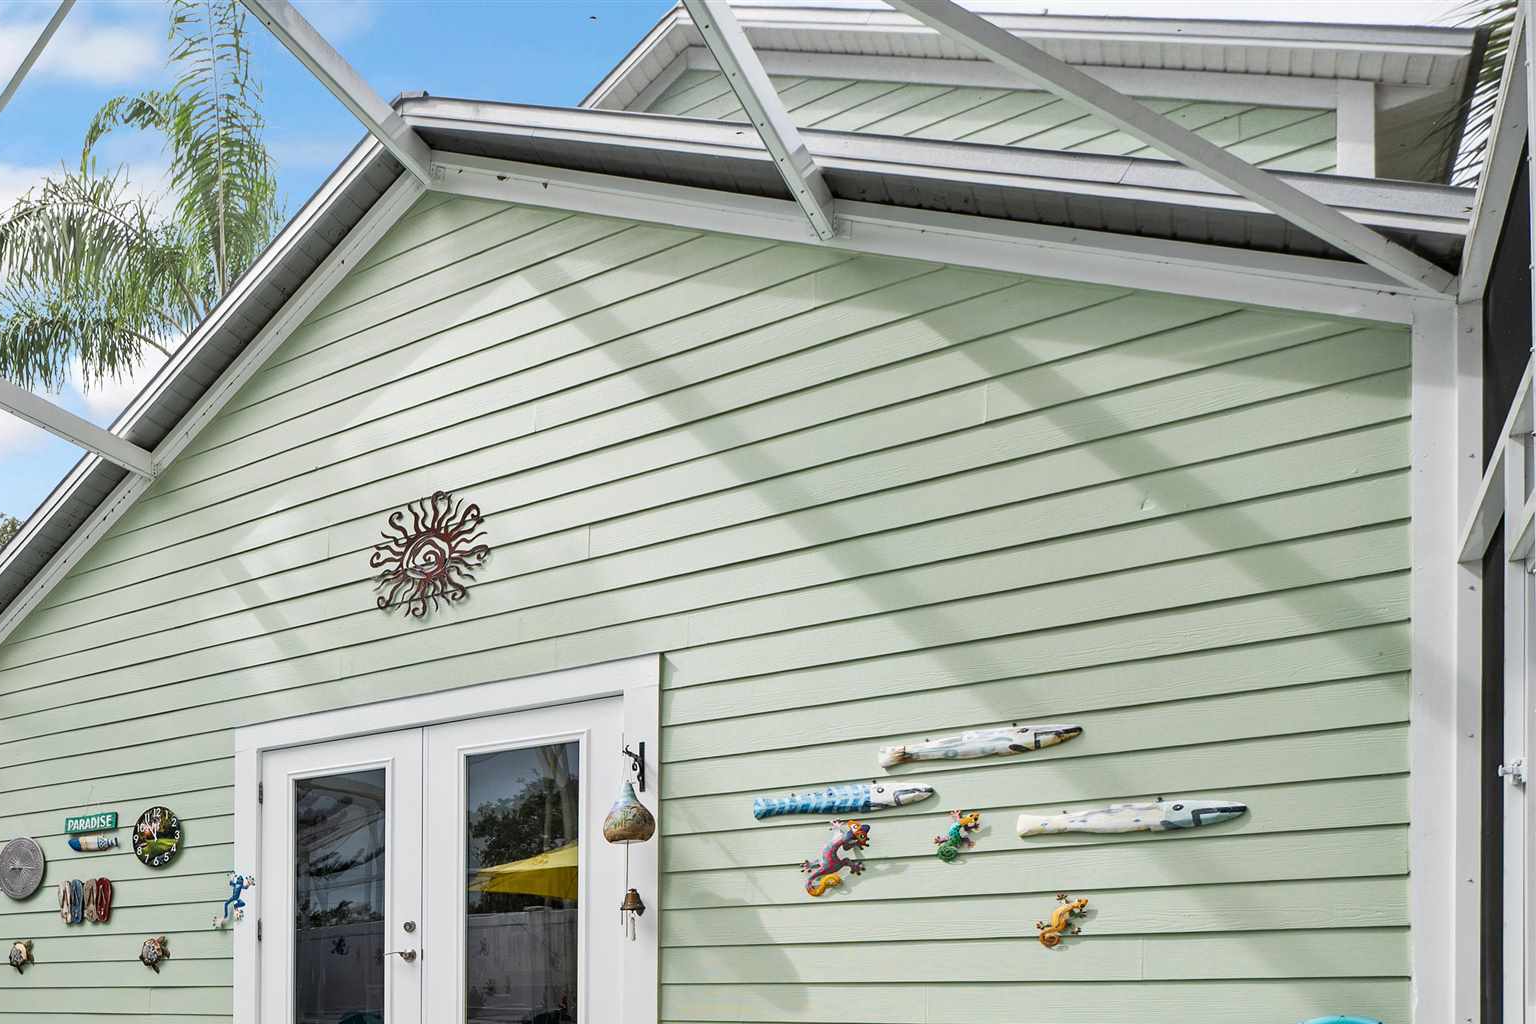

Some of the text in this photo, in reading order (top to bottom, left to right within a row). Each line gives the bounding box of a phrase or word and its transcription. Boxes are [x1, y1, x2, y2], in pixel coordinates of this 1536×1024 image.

[153, 808, 160, 817] 12
[165, 810, 168, 819] 1
[67, 815, 112, 831] PARADISE
[171, 818, 176, 827] 2
[137, 823, 145, 832] 10
[133, 834, 138, 843] 9
[174, 830, 180, 839] 3
[136, 846, 142, 855] 8
[170, 843, 176, 852] 4
[144, 854, 149, 863] 7
[153, 856, 159, 866] 6
[163, 852, 169, 861] 5
